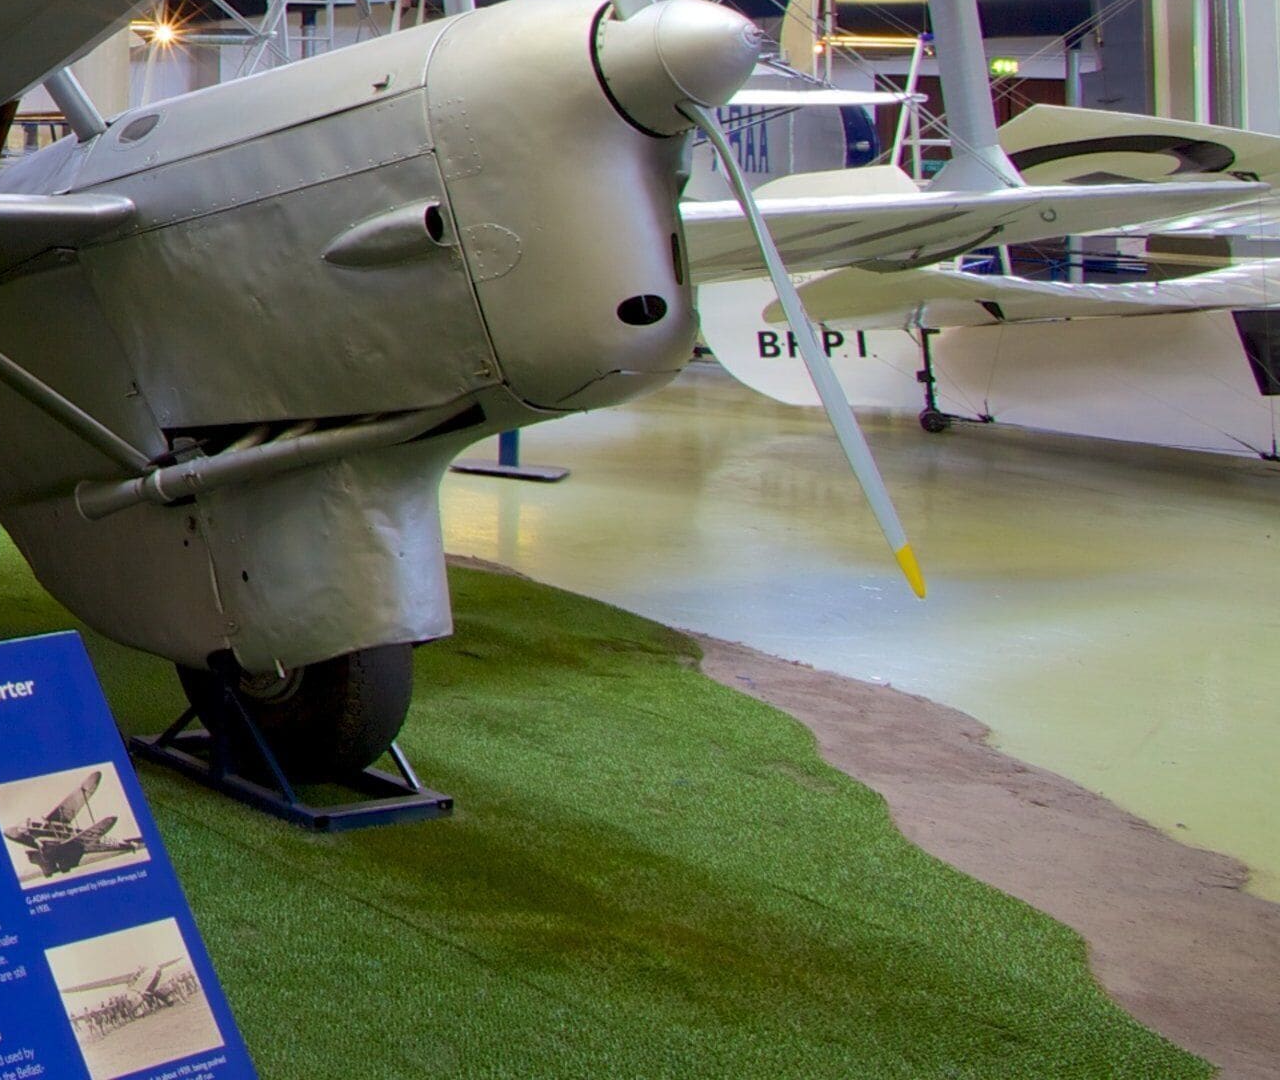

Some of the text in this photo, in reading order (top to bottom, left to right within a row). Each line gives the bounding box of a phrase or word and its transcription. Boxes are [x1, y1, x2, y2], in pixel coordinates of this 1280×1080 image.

[0, 971, 13, 982] are
[13, 965, 27, 978] still
[4, 1049, 24, 1064] used
[23, 1046, 35, 1060] by
